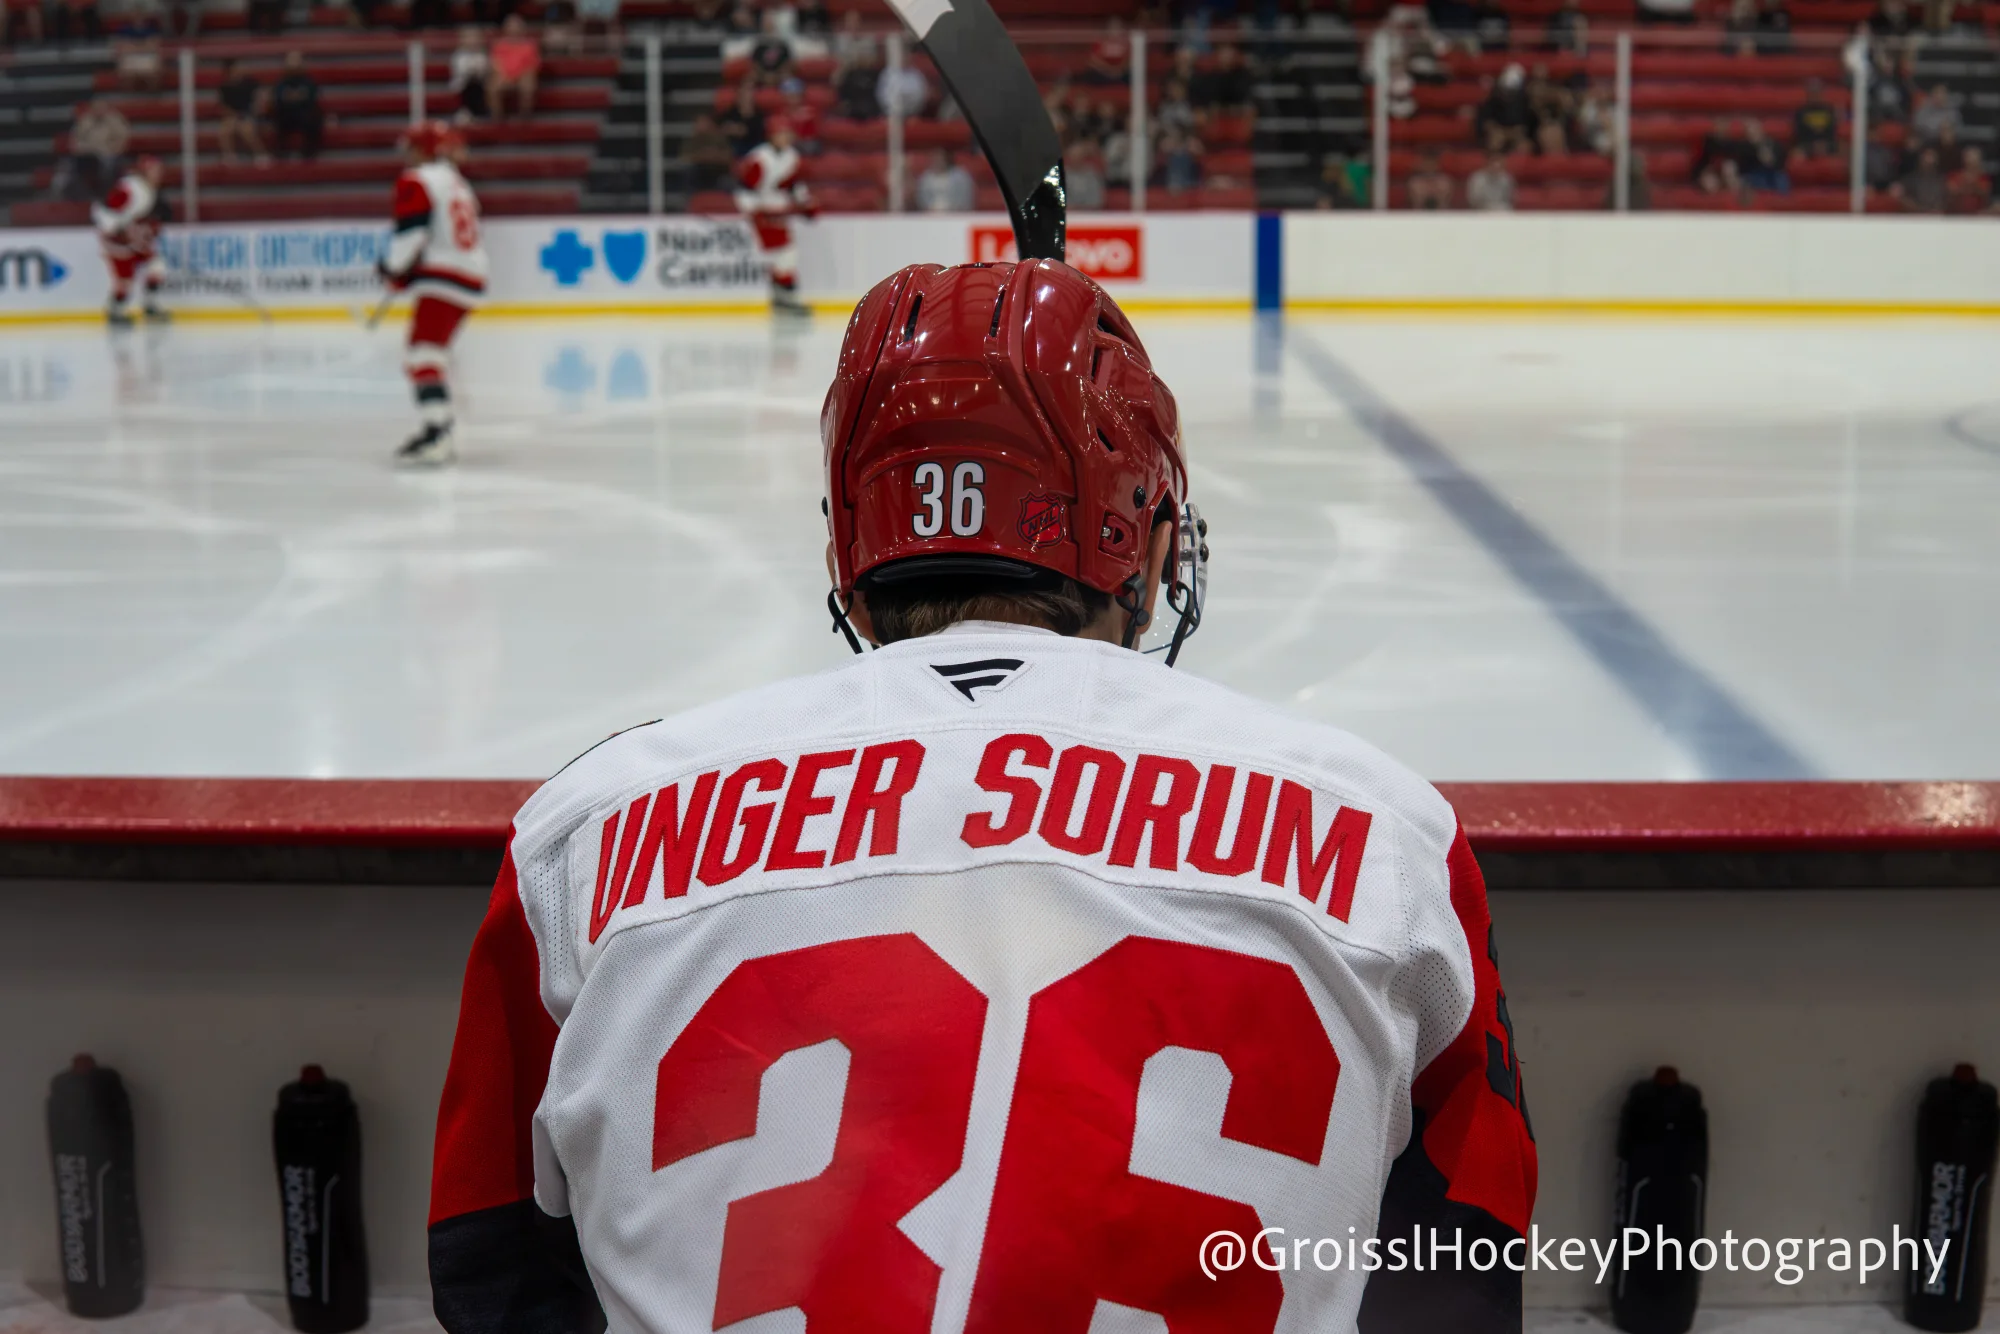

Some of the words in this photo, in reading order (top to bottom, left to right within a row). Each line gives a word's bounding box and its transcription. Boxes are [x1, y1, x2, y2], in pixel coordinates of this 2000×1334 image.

[656, 228, 755, 252] North
[656, 255, 772, 289] Carolin
[912, 461, 986, 538] 36
[1027, 510, 1058, 535] NHL
[588, 739, 926, 945] UNGER
[960, 733, 1374, 924] SORUM
[651, 931, 1341, 1334] 36
[56, 1153, 88, 1284] BODYARMOR
[284, 1164, 312, 1298] BODYARMOR
